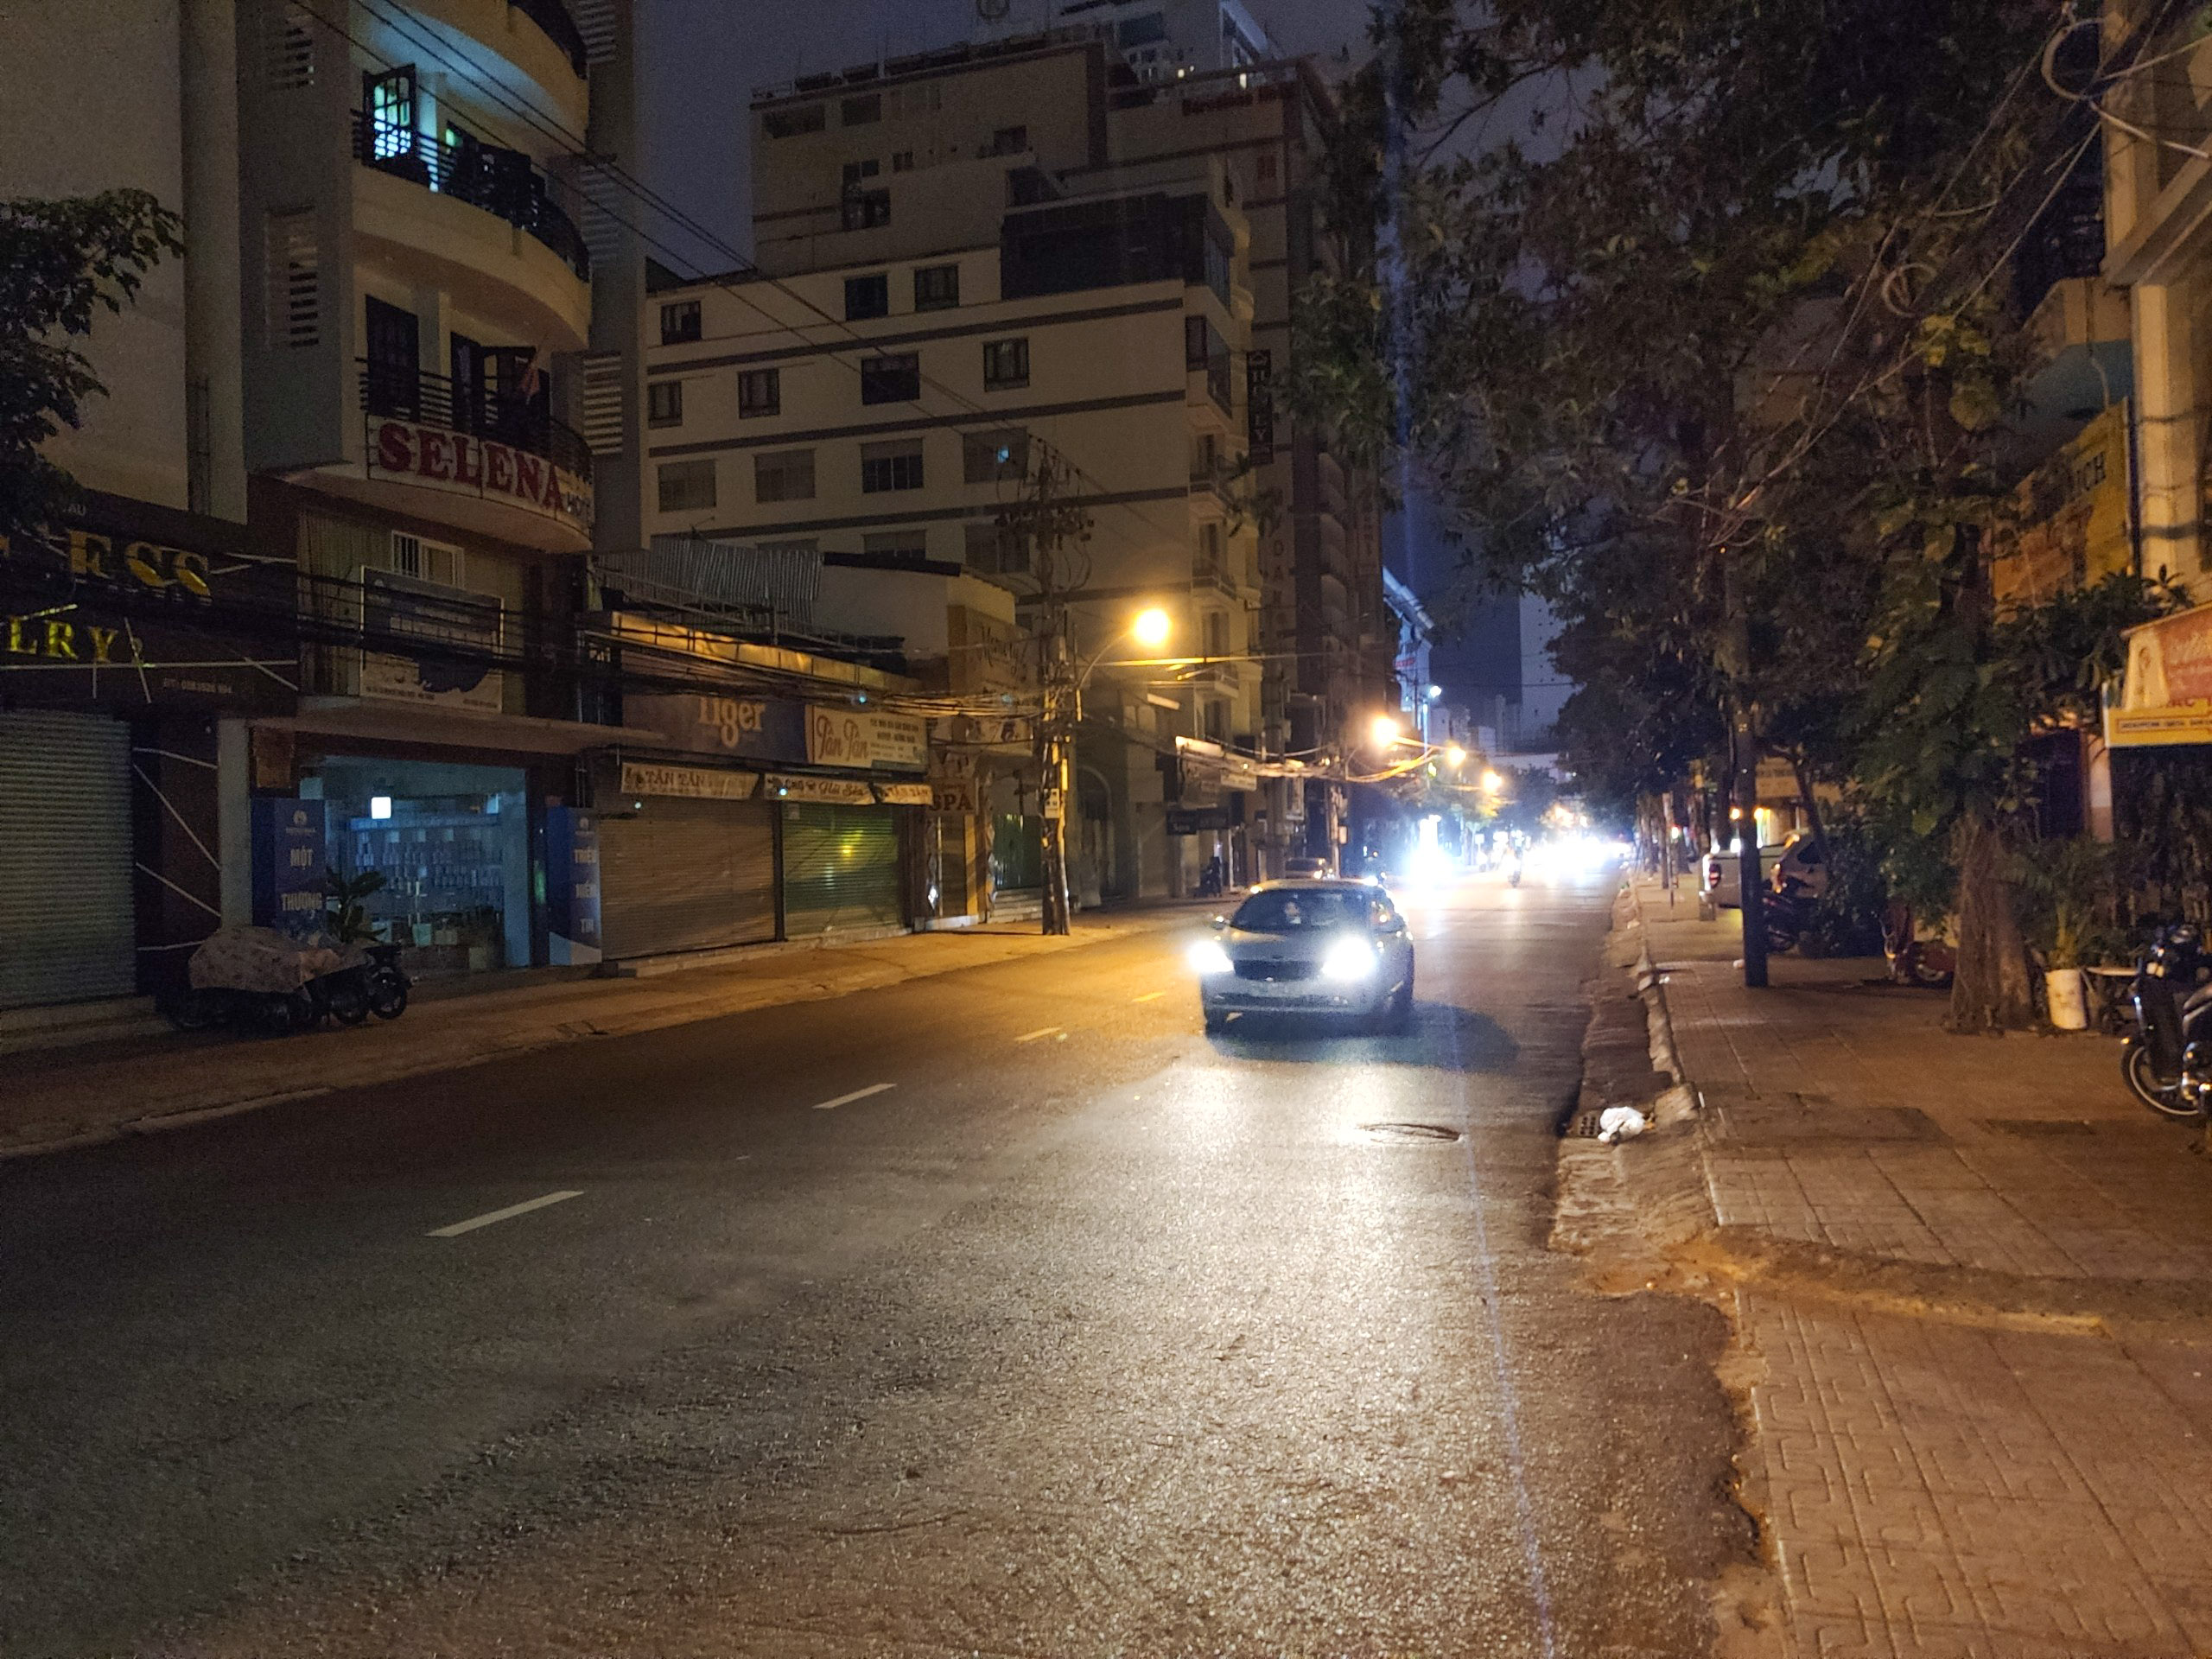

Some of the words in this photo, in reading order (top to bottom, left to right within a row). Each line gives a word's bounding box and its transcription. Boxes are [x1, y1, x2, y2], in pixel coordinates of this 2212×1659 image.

[378, 423, 564, 510] SELENA
[33, 526, 213, 598] ESS
[930, 793, 974, 810] SPA
